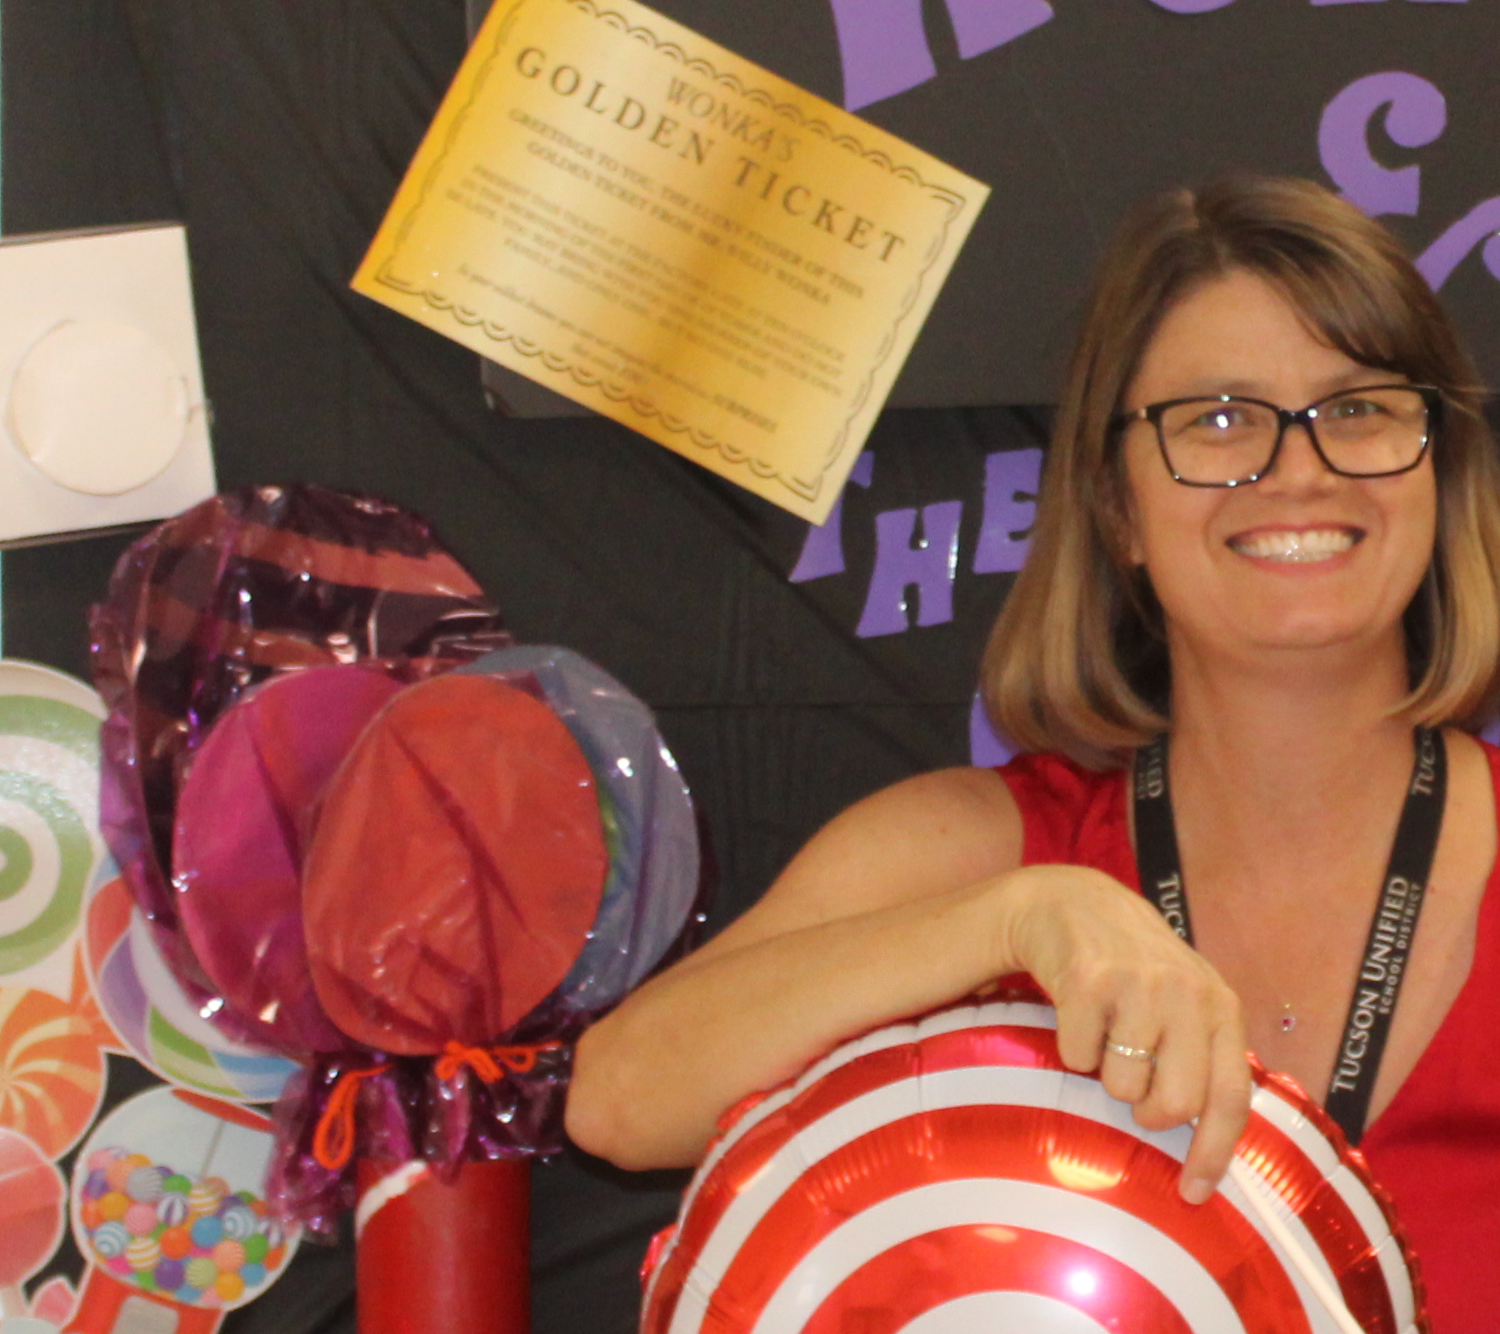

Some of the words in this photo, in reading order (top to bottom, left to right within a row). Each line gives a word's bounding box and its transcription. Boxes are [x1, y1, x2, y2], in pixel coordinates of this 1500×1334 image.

[514, 44, 714, 167] GOLDEN
[730, 154, 907, 265] TICKET
[664, 75, 798, 163] WONKA'S
[788, 448, 1043, 638] THE
[1329, 989, 1379, 1094] TUCSON
[1361, 873, 1408, 986] UNIFIED
[1378, 953, 1404, 1015] SCHOOL
[1396, 881, 1423, 950] DISTRICT
